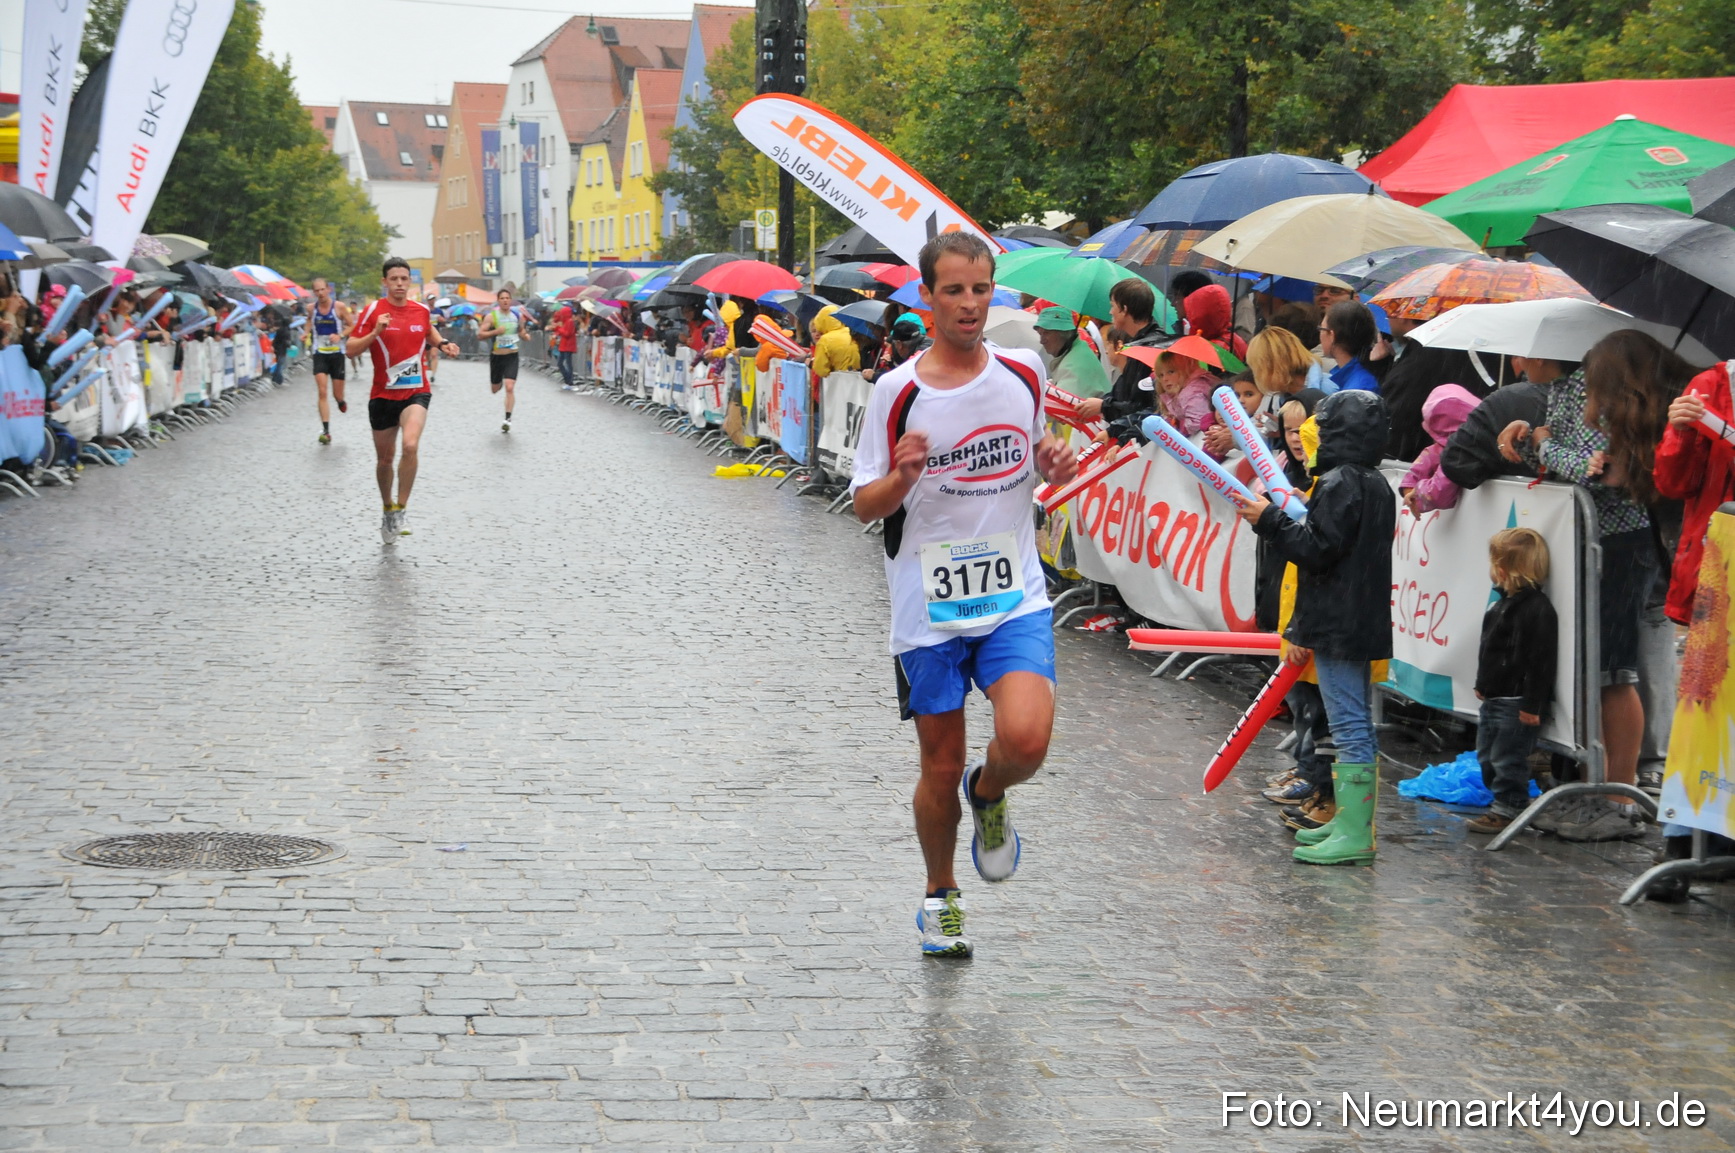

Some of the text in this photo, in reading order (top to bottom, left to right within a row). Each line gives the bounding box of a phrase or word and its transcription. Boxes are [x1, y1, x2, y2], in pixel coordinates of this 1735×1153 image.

[33, 34, 64, 195] Audi BKK
[116, 76, 170, 214] Audi BKK
[926, 434, 1020, 468] GERHART &
[1219, 392, 1276, 482] TUI ReiseCenter
[966, 447, 1023, 472] JÄNIG
[1153, 429, 1226, 491] ReiseCenter
[938, 470, 1031, 498] Das sportliche Autohaus
[950, 541, 989, 556] BOCK
[932, 557, 1014, 600] 3179
[955, 602, 999, 617] Jürgen
